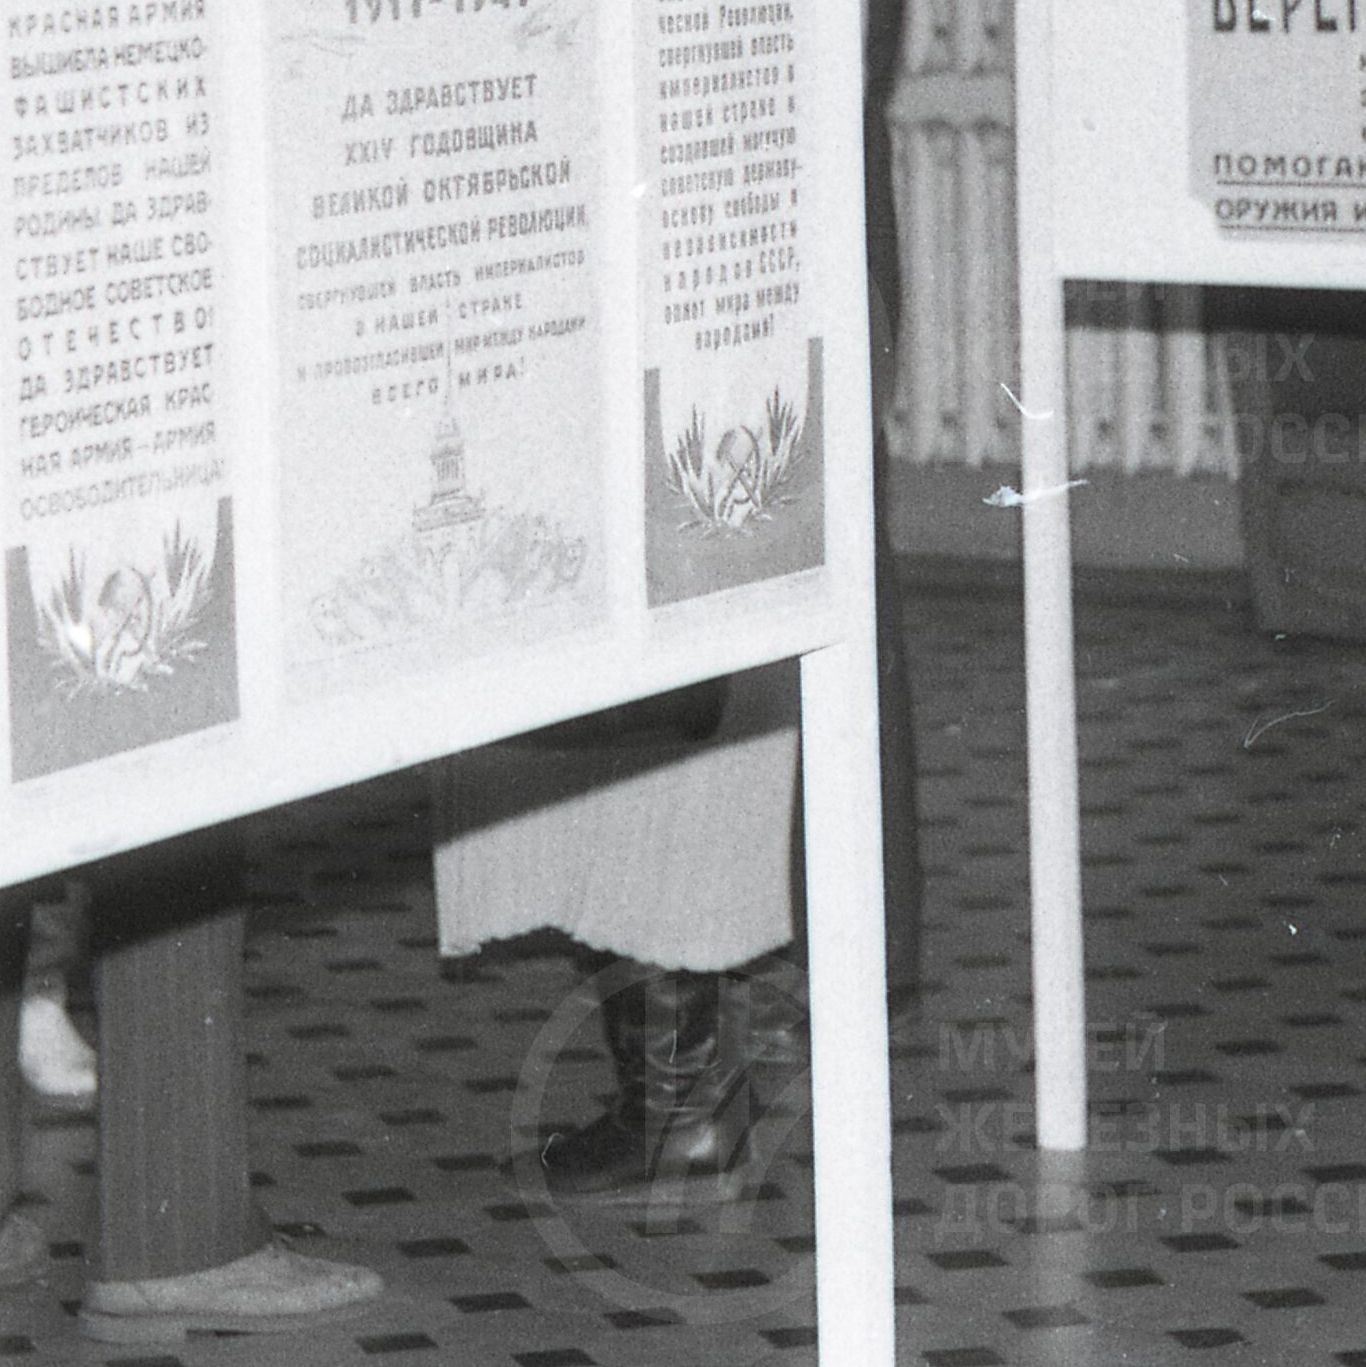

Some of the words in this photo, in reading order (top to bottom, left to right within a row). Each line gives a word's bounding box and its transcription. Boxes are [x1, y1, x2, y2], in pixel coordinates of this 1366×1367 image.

[9, 5, 119, 37] КРАСНАЯ
[14, 76, 206, 119] ФАШИСТСКИХ
[341, 93, 374, 123] ДА
[386, 74, 537, 116] ЗДРАВСТВУЕТ
[14, 119, 168, 160] ЗАХВАТЧИКОВ
[186, 113, 209, 136] ИЗ
[410, 120, 538, 159] ГОДОВЩИНА
[313, 176, 408, 220] ВЕЛИКОЙ
[423, 155, 570, 203] ОКТЯБРЬСКОЙ
[1216, 198, 1338, 223] ОРУЖИЯ
[16, 247, 99, 281] СТВУЕТ
[107, 237, 163, 265] НАШЕ
[296, 215, 480, 270] СОЦИАЛИСТИЧЕСКОЙ
[106, 268, 212, 305] СОВЕТСКОЕ
[410, 269, 460, 294] ВЛАСТЬ
[459, 293, 522, 320] СТРАНЕ
[64, 343, 214, 394] ЗДРАВСТВУЕТ
[20, 394, 151, 438] ГЕРОИЧЕСКАЯ
